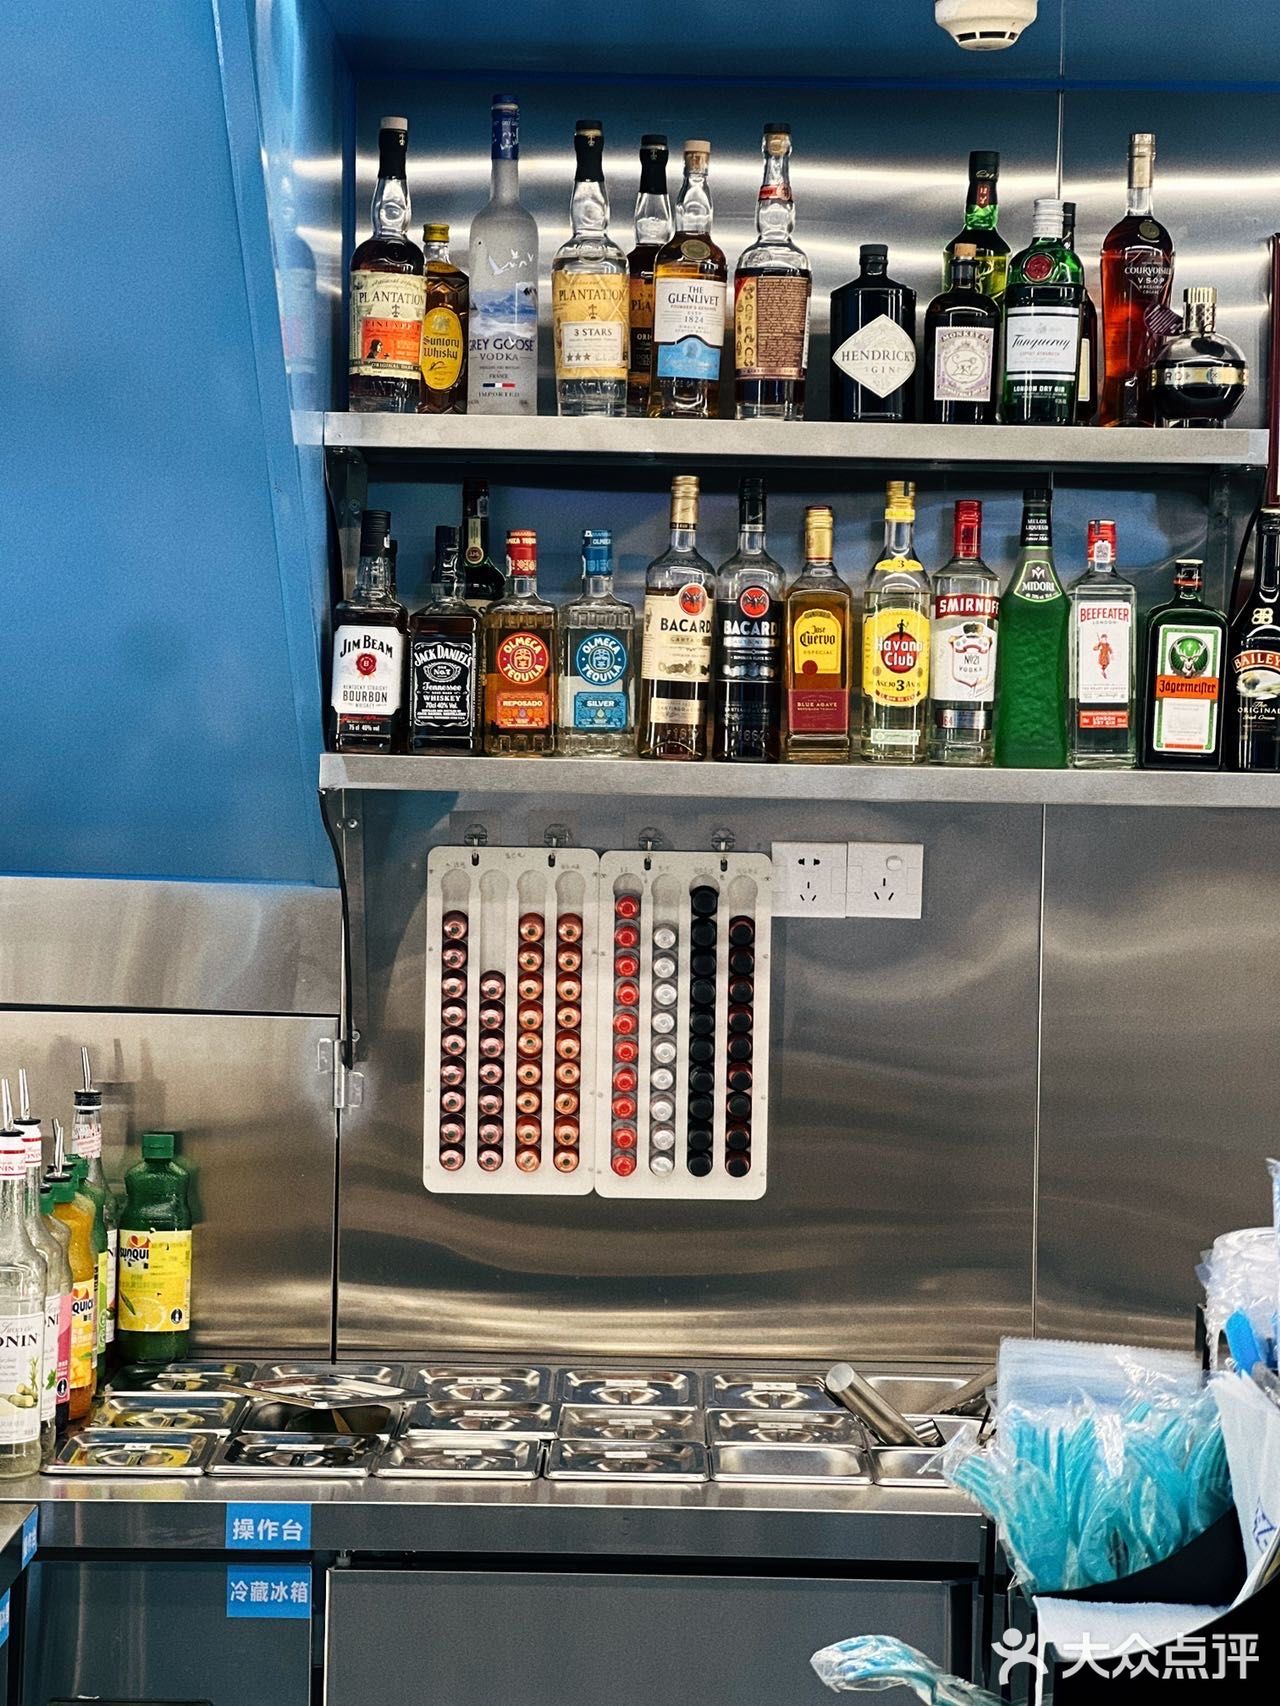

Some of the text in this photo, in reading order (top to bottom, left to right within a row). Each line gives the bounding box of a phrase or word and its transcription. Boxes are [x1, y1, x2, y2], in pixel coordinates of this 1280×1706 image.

[559, 289, 625, 301] PLANTATION
[688, 286, 704, 294] THE
[359, 290, 424, 305] PLANTATION
[668, 292, 720, 306] GLENLIVET
[574, 328, 612, 336] 3 STARS
[423, 335, 460, 349] Suntory
[494, 339, 534, 351] GOOSE
[1012, 334, 1071, 350] Tanqueray
[424, 346, 458, 360] Whisky
[897, 560, 905, 568] 3
[1022, 581, 1056, 592] MIDORI
[1080, 607, 1129, 622] BEEFEATER
[503, 636, 543, 654] OLMECA
[582, 637, 619, 655] OLMECA
[800, 631, 836, 647] Cuervo
[340, 635, 393, 659] JIM BEAM
[414, 644, 473, 668] JACK DANIEL'S
[885, 652, 914, 667] Club
[503, 664, 544, 682] TEQUILA
[581, 664, 622, 683] TEQUILA
[422, 681, 462, 691] Tennessee
[896, 679, 905, 691] 3
[343, 690, 388, 703] BOURBON
[423, 694, 461, 702] WHISKEY
[232, 1518, 304, 1542] 操作台
[230, 1580, 309, 1604] 冷藏冰箱
